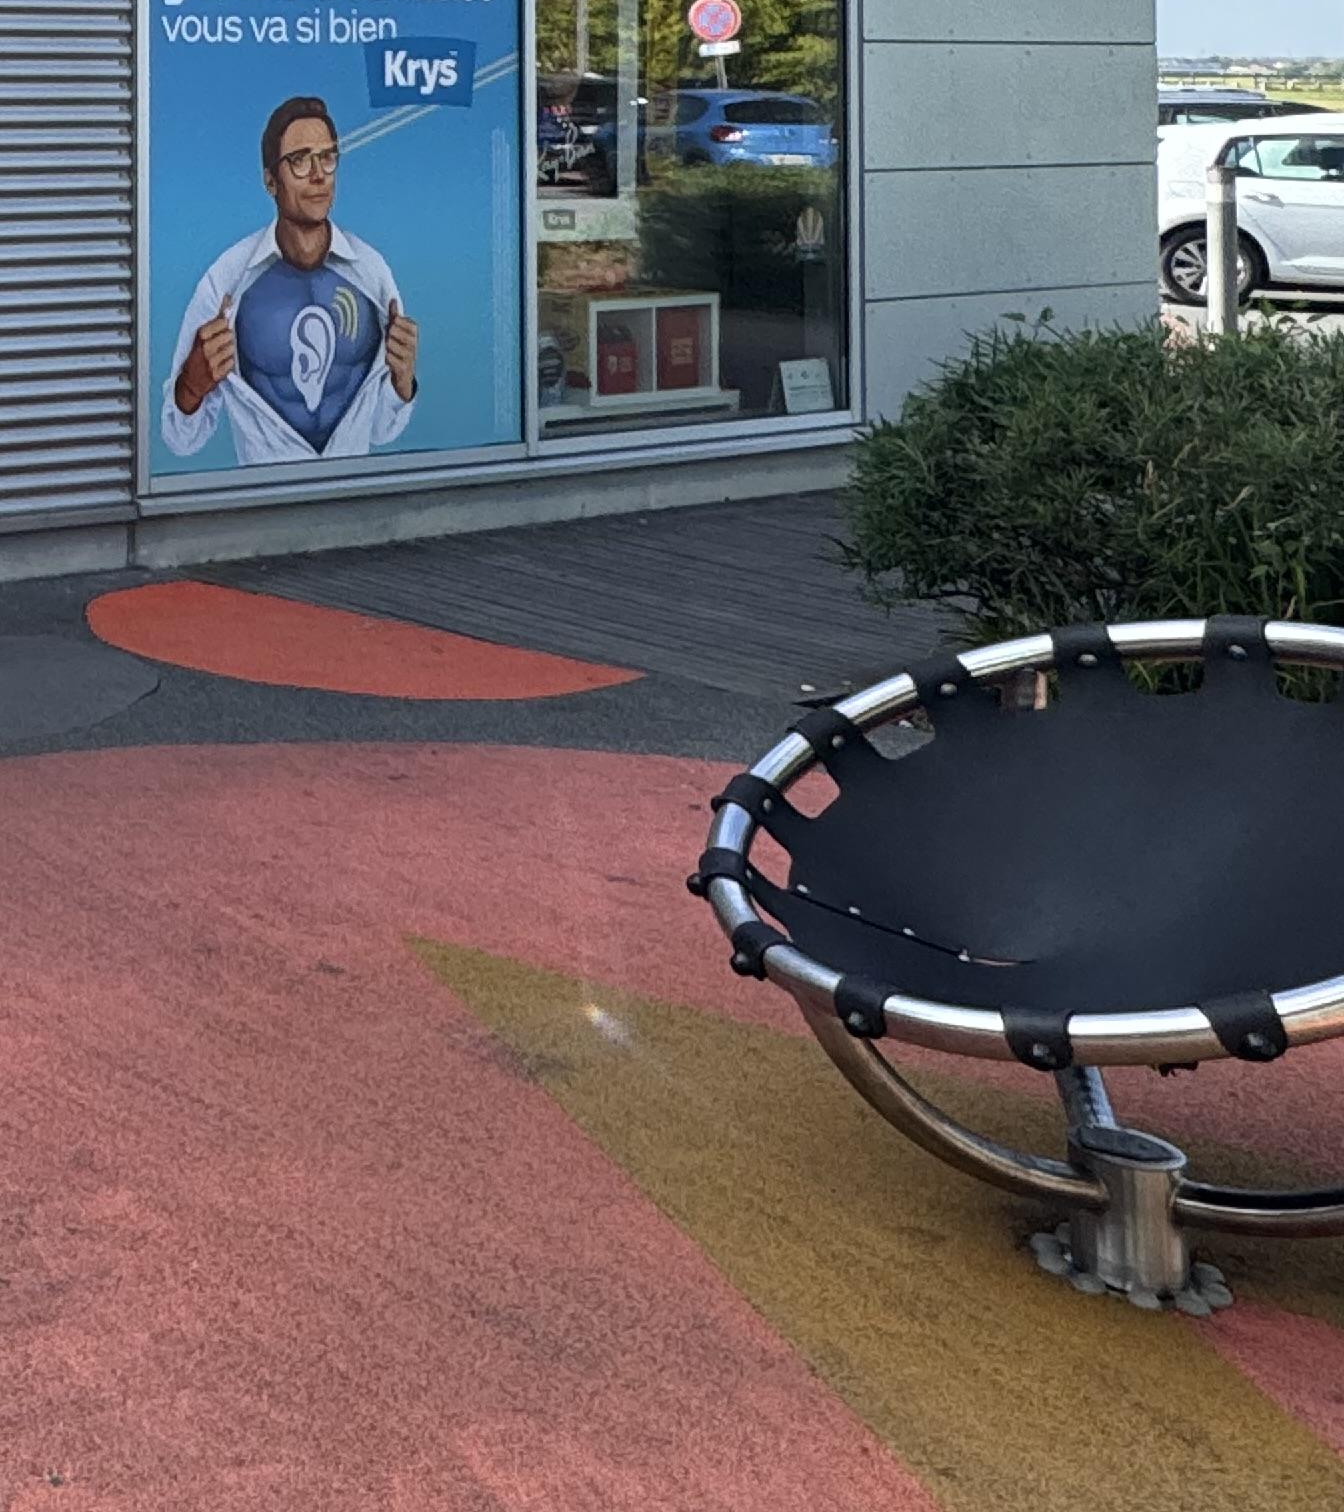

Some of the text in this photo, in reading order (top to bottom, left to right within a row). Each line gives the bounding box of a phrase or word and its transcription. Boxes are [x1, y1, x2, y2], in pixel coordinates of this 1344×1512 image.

[161, 8, 398, 43] vous va si bien
[384, 50, 458, 95] Krys
